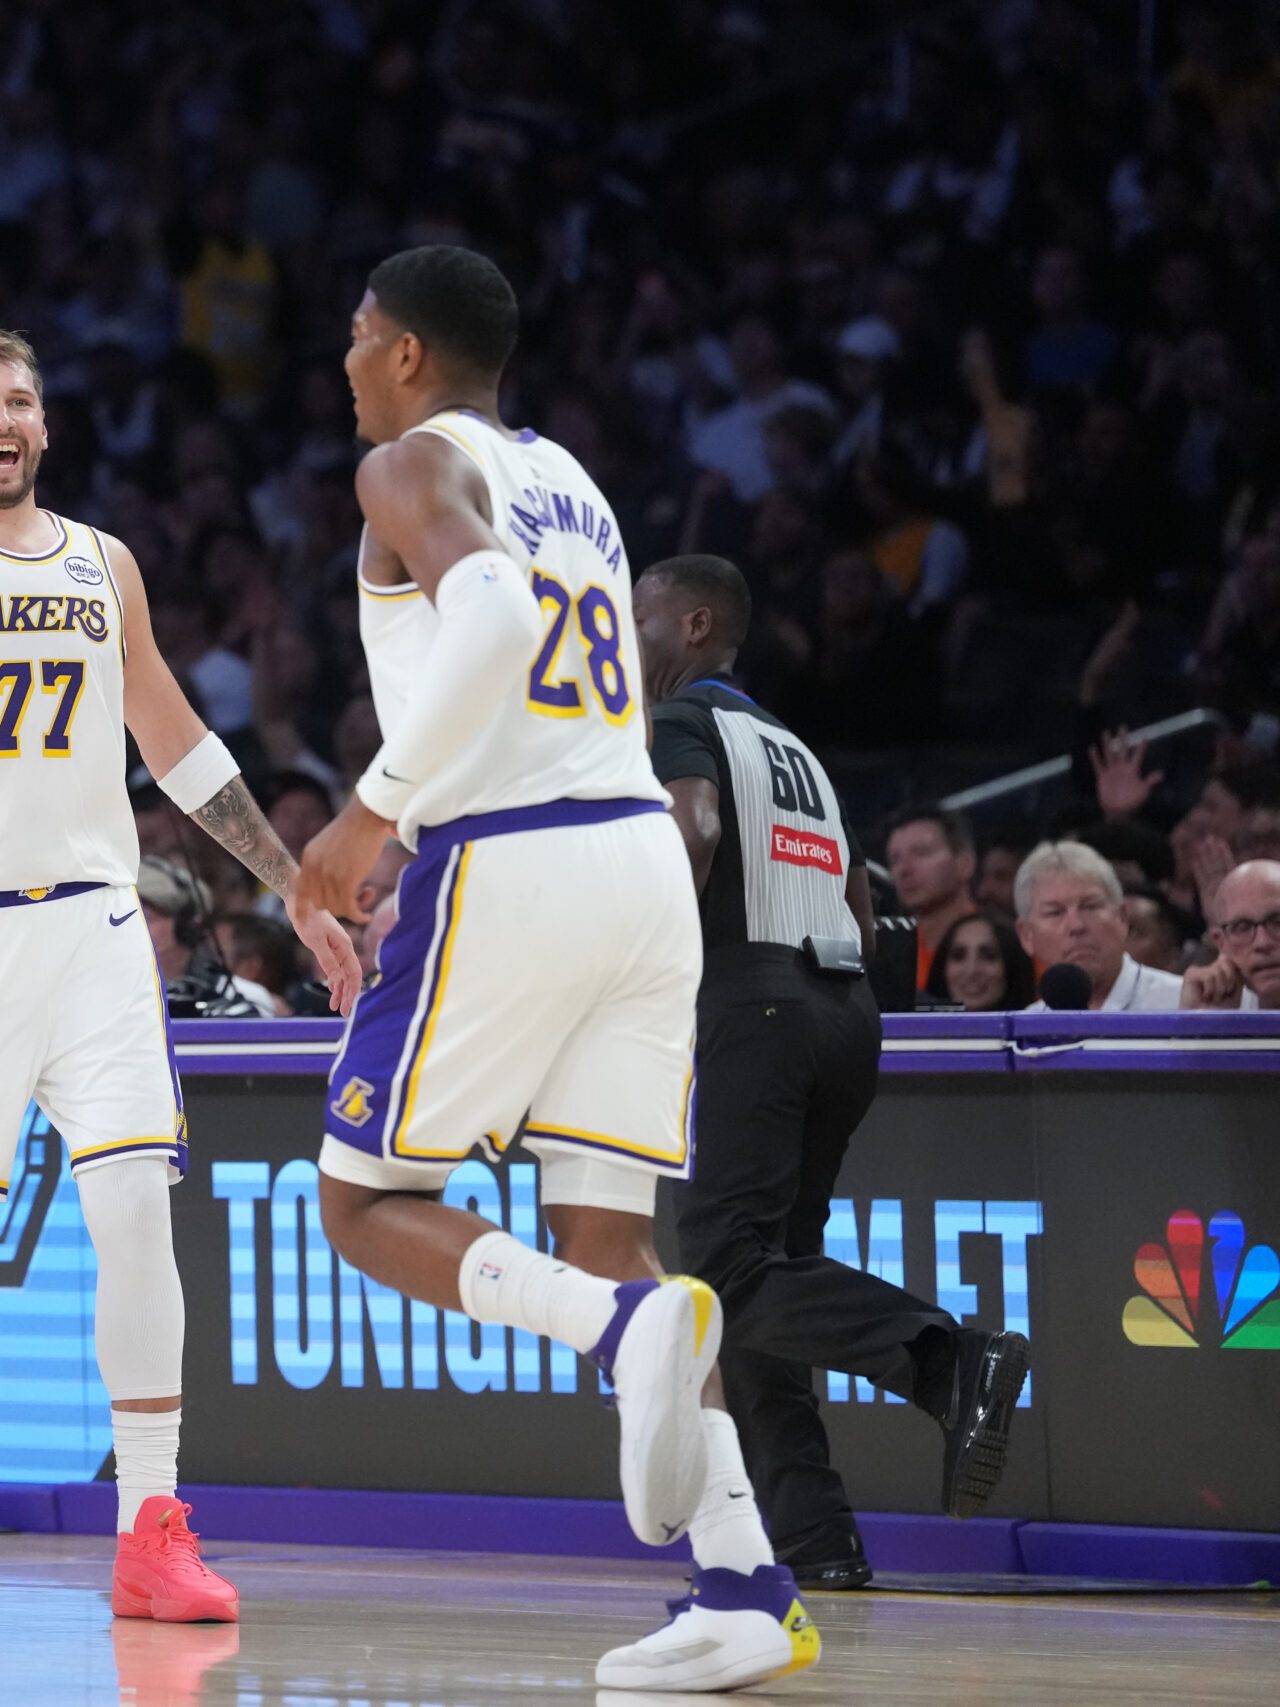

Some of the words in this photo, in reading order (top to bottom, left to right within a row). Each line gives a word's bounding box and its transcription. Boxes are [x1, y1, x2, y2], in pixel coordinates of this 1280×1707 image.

[68, 563, 100, 578] bibigo
[526, 565, 635, 728] 28
[759, 734, 826, 821] 60
[775, 833, 833, 864] Emirates
